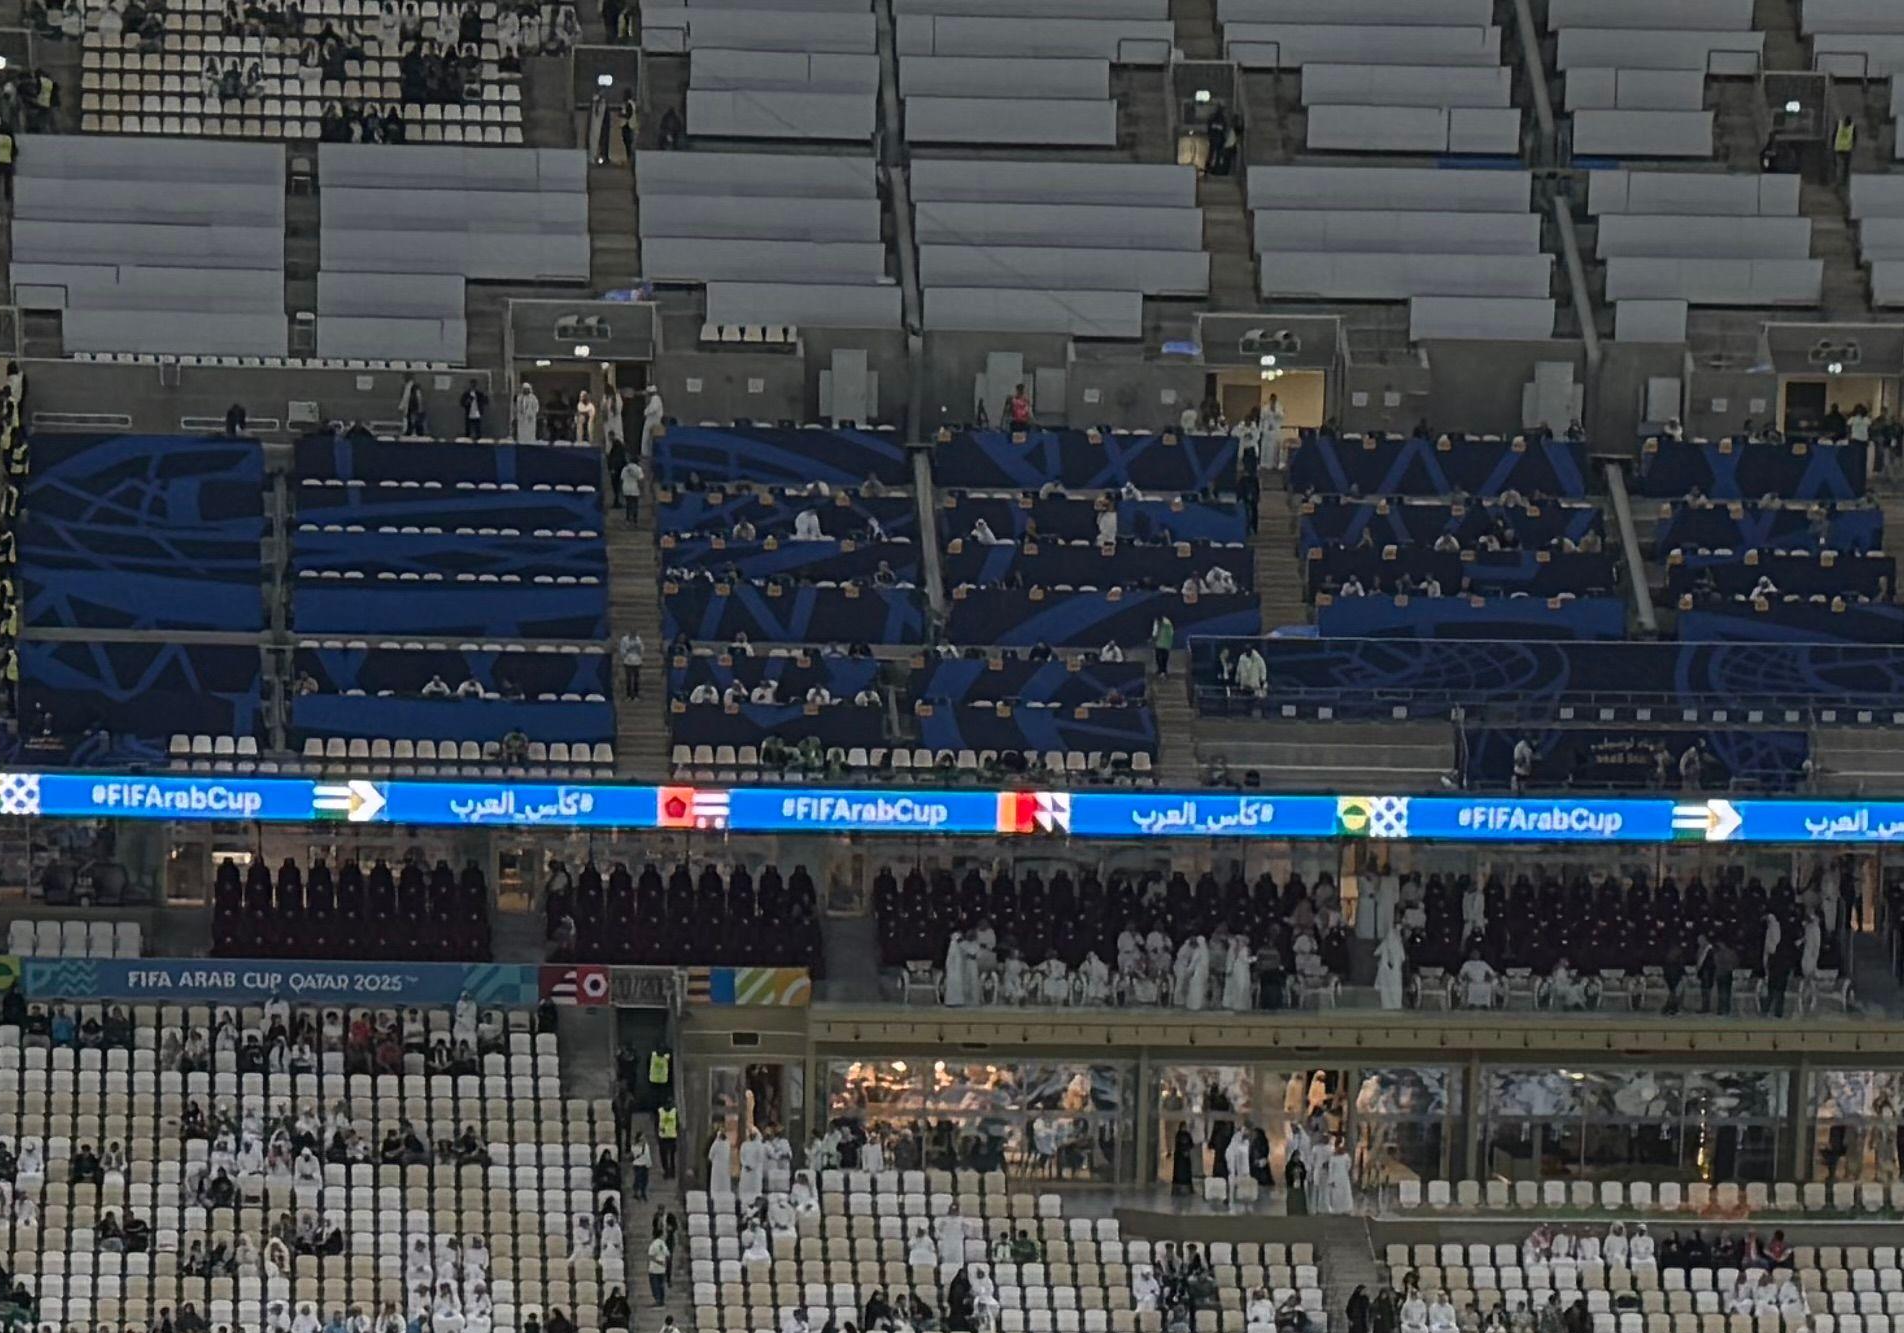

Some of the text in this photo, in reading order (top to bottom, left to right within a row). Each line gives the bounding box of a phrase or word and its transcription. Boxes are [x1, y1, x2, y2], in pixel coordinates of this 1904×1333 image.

[92, 784, 262, 816] #FIFArabCup
[783, 797, 947, 827] #FIFArabCup
[1459, 807, 1623, 838] #FIFArabCup
[127, 971, 172, 988] FIFA
[178, 972, 236, 988] ARAB
[243, 973, 282, 990] CUP
[288, 974, 348, 993] QATAR
